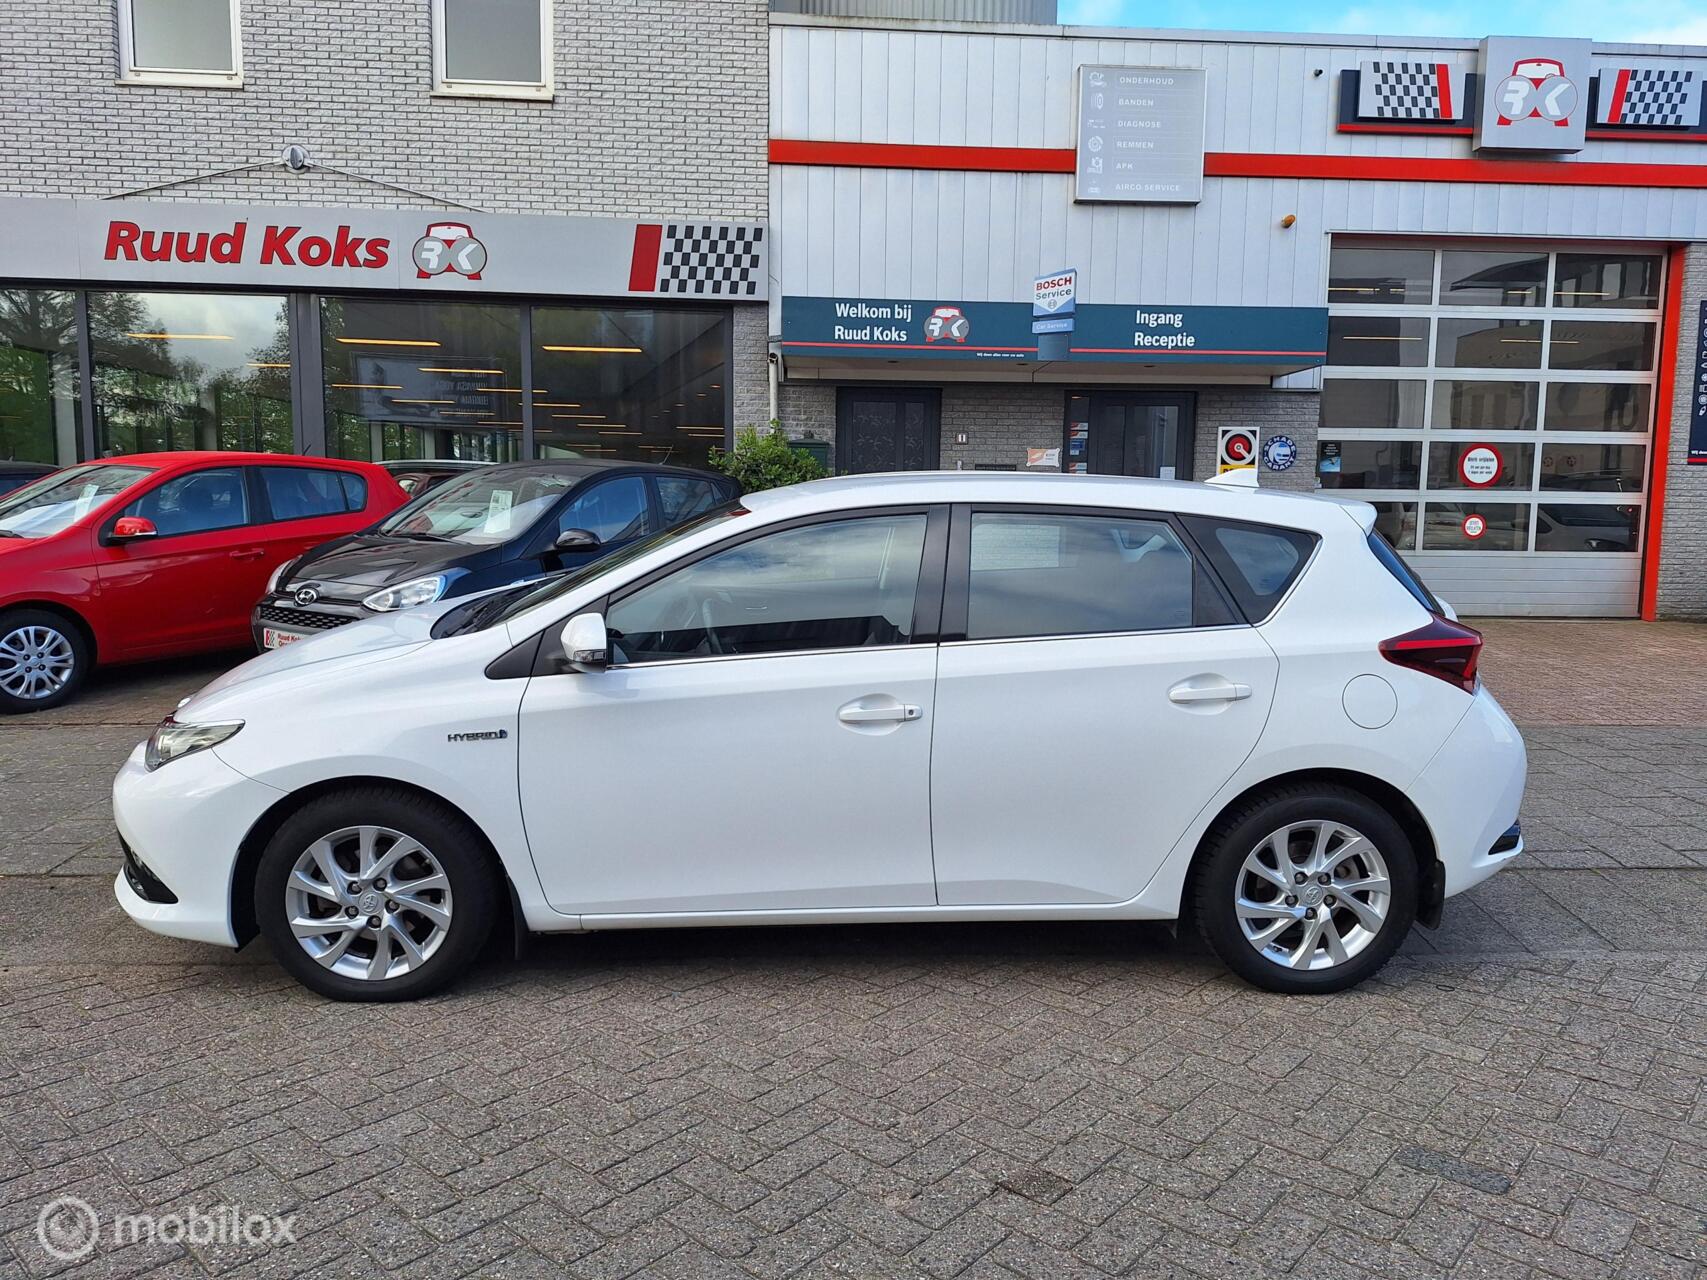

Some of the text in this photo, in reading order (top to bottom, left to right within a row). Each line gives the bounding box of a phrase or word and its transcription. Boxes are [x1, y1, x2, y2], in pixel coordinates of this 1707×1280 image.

[1119, 76, 1174, 86] ONDERHOUD
[1118, 97, 1154, 106] BANDEN
[1117, 120, 1161, 129] DIAGNOSE
[1116, 141, 1154, 149] REMMEN
[1115, 162, 1134, 170] APK
[1115, 183, 1180, 192] AIRCO SERVICE
[104, 220, 391, 269] Ruud Koks
[1036, 276, 1073, 291] BOSCH
[1035, 288, 1072, 301] Service
[835, 303, 912, 323] Welkom bij
[1136, 310, 1183, 328] Ingang
[834, 325, 907, 342] Ruud Koks
[1134, 332, 1195, 350] Receptie
[1264, 436, 1296, 452] SCHADE
[447, 731, 498, 742] HYBRID
